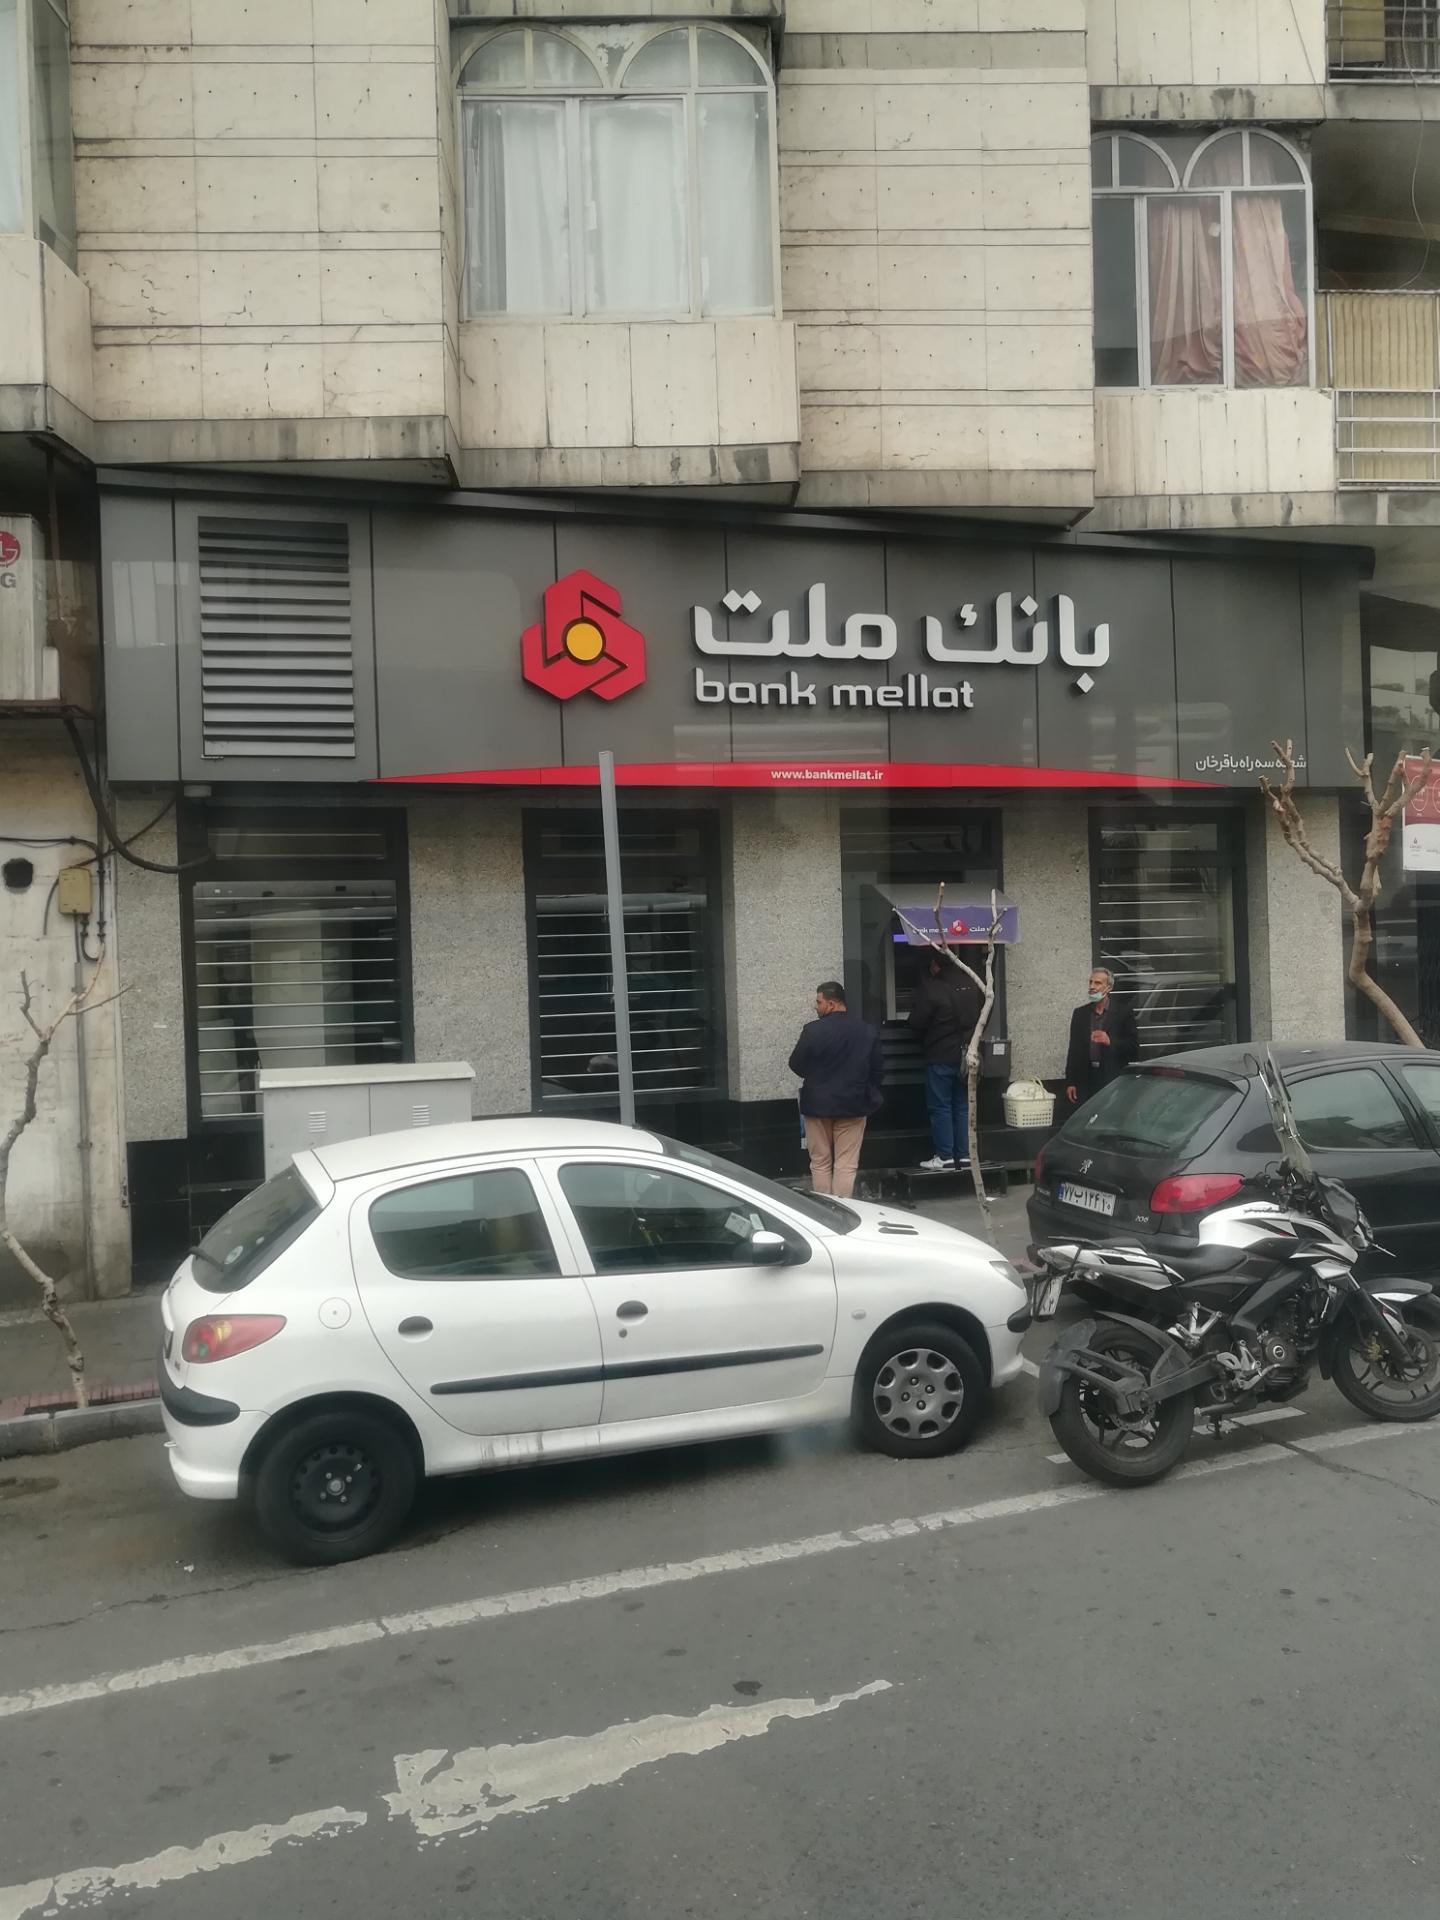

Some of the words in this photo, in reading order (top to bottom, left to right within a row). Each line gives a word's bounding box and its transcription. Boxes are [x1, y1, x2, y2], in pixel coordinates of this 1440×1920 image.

[694, 582, 898, 661] ملت
[695, 667, 817, 705] bank
[833, 672, 975, 708] mellat
[1195, 753, 1239, 773] باقرخان
[1239, 755, 1254, 771] راه
[1255, 758, 1274, 769] سه
[770, 769, 884, 782] www.bankmellat.ir
